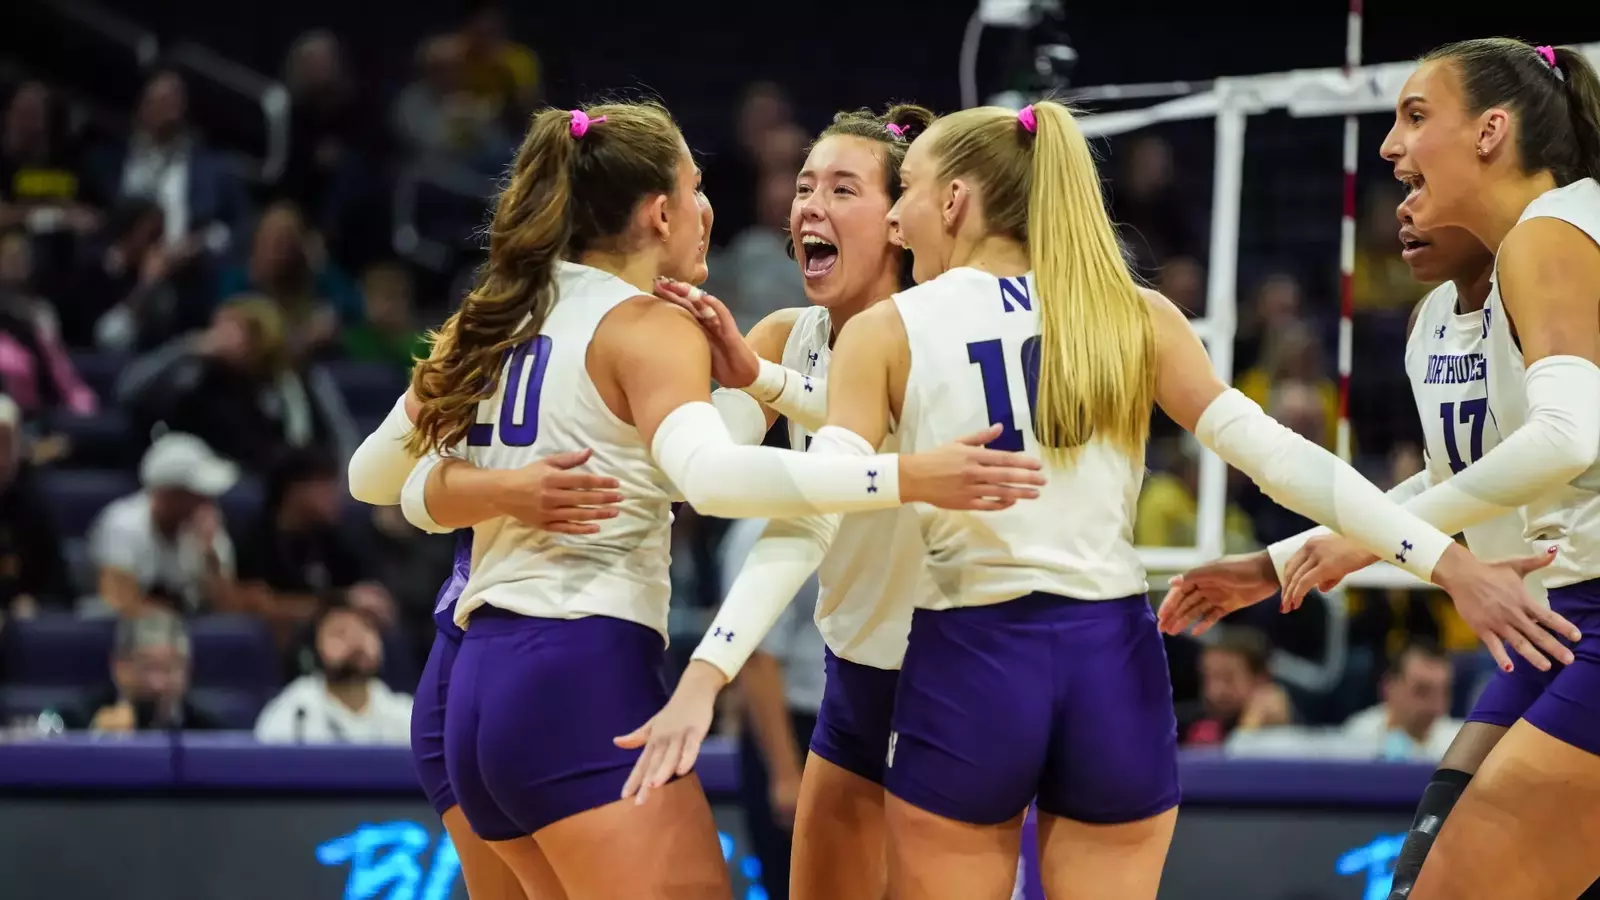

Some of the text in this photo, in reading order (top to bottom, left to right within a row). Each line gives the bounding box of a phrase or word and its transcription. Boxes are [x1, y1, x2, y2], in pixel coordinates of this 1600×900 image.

[998, 276, 1032, 312] N
[466, 334, 553, 447] 0
[1440, 397, 1488, 475] 17
